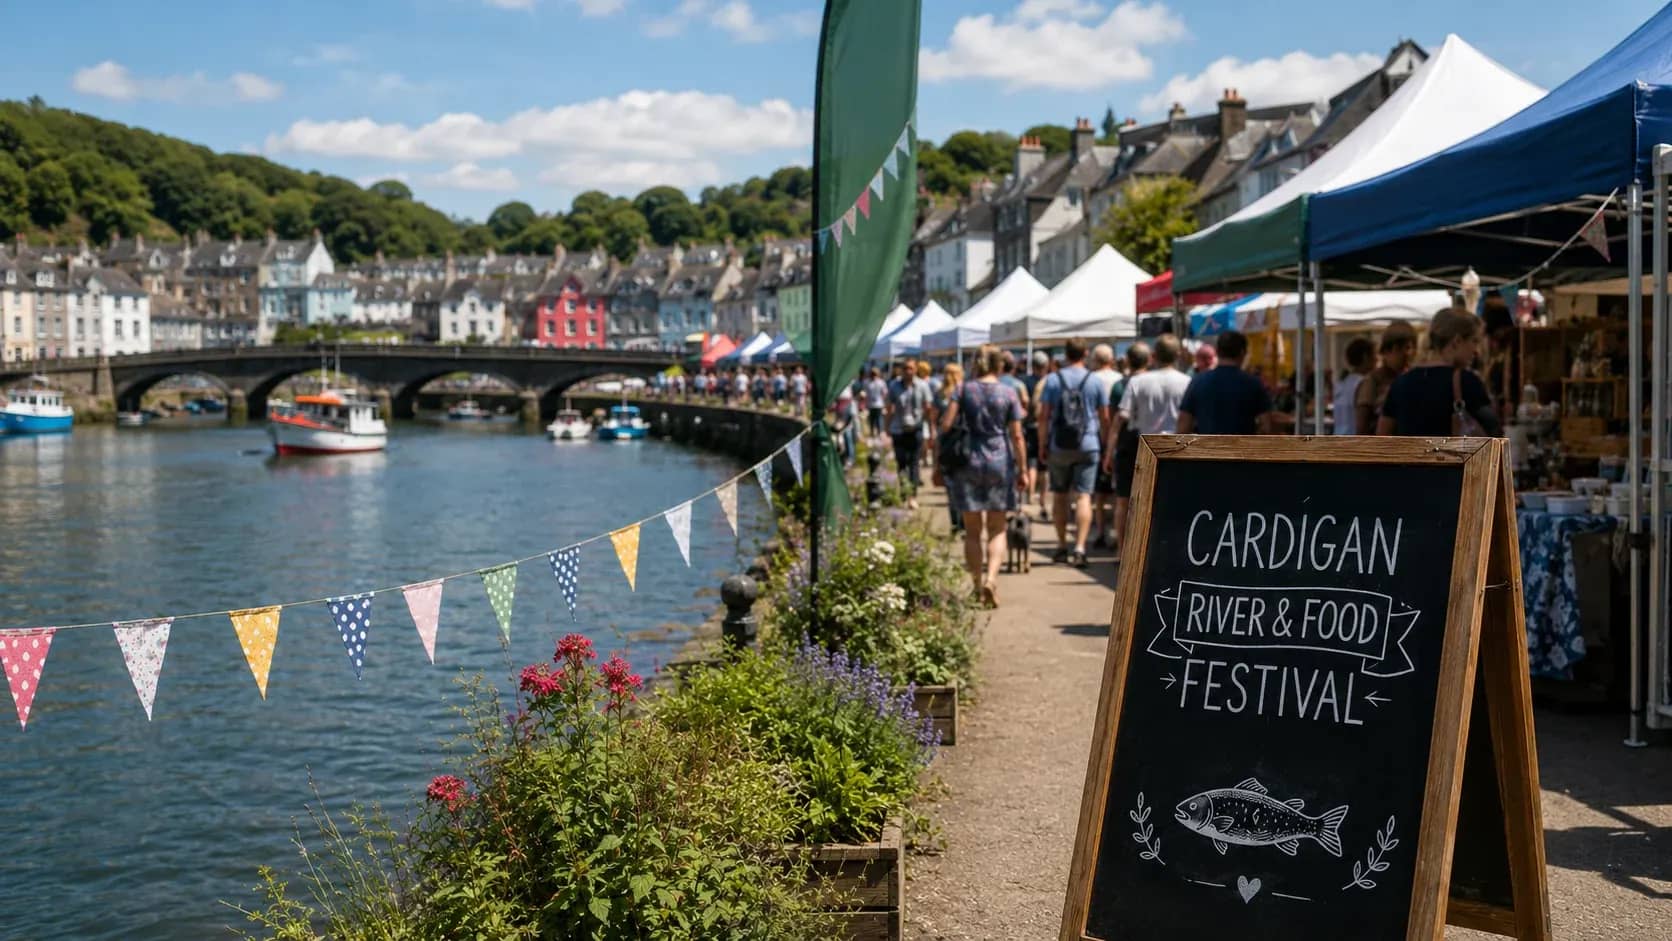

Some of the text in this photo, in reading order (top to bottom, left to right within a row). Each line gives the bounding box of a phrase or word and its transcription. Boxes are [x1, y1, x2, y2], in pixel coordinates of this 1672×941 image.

[1187, 510, 1402, 576] CARDIGAN
[1186, 593, 1378, 644] RIVER & FOOD
[1180, 658, 1364, 725] FESTIVAL
